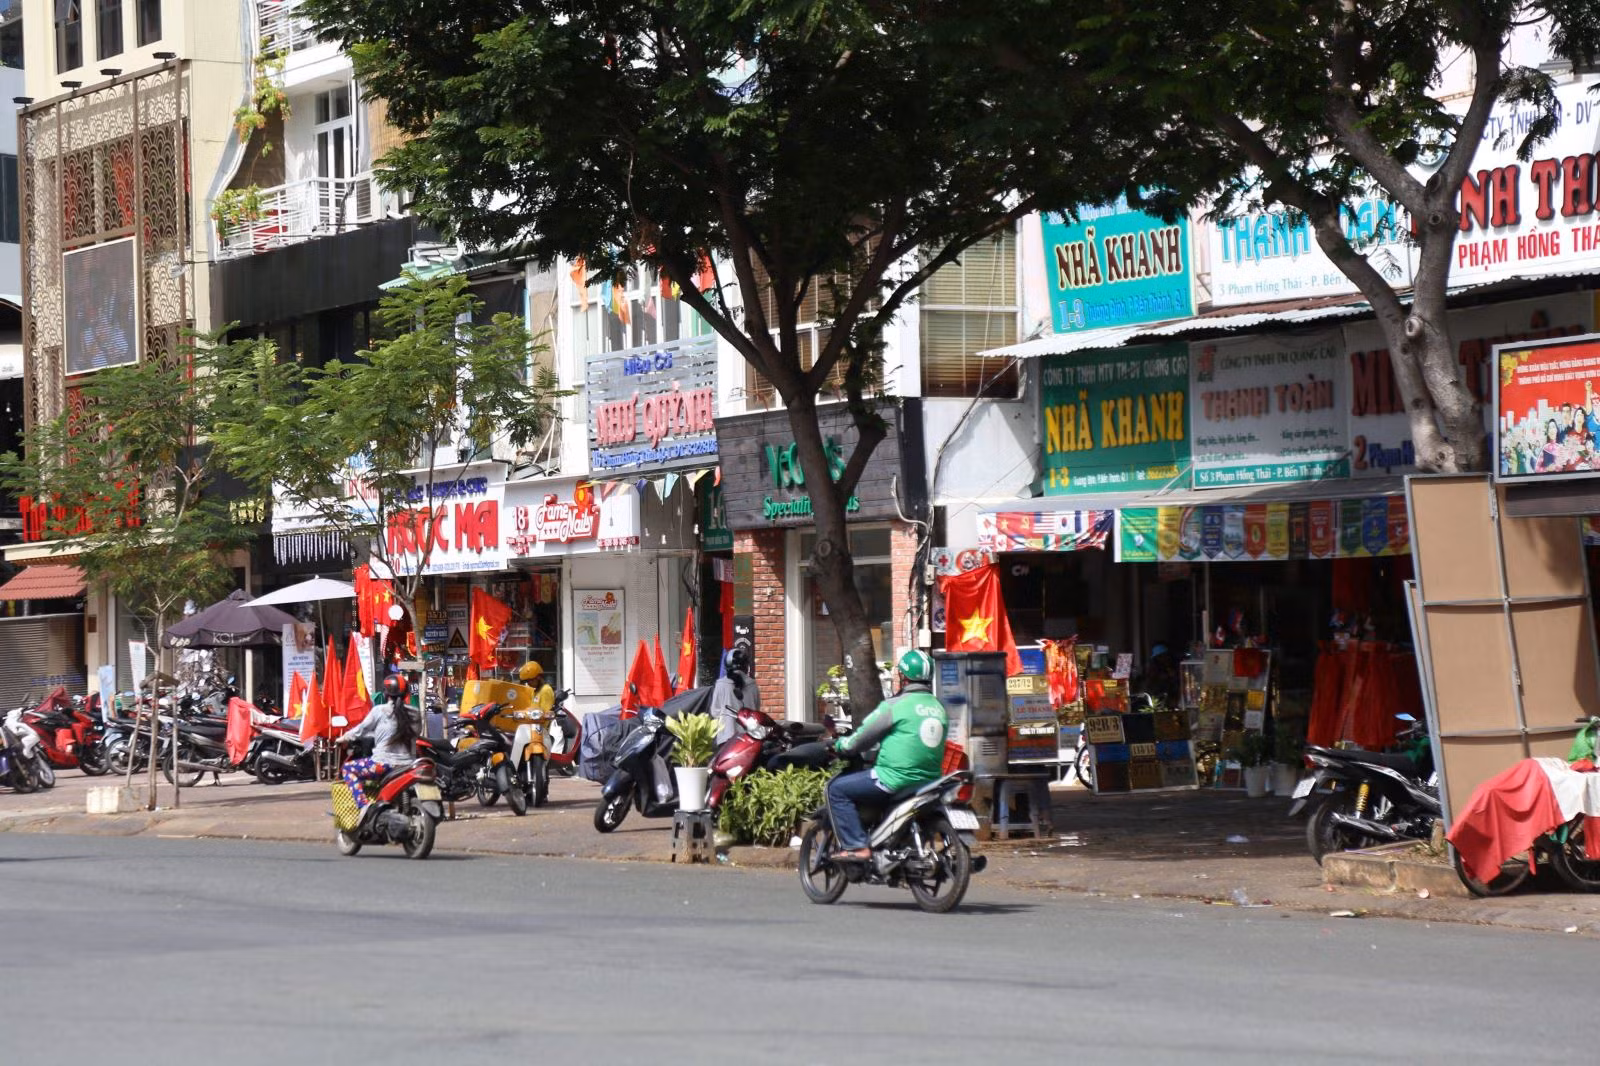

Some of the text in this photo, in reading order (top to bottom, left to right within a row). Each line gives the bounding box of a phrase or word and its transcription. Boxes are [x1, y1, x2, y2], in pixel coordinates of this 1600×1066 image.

[1055, 225, 1182, 290] NHÃ KHANH
[1459, 238, 1508, 271] PHẠM
[1518, 225, 1560, 261] HỒNG
[1219, 283, 1226, 296] 3
[1228, 283, 1252, 297] Phạm
[1058, 299, 1085, 330] 1-3
[1274, 373, 1334, 414] TOÀN
[596, 391, 638, 447] NHƯ
[1045, 388, 1185, 455] NHÃ KHANH
[1354, 435, 1368, 471] 2
[1050, 466, 1070, 488] 1-3
[1210, 472, 1215, 482] 3
[1216, 471, 1235, 485] Phạm
[1236, 468, 1255, 482] Hồng
[514, 506, 594, 543] 18 Nails
[535, 494, 569, 531] Fame
[915, 703, 946, 720] Grab
